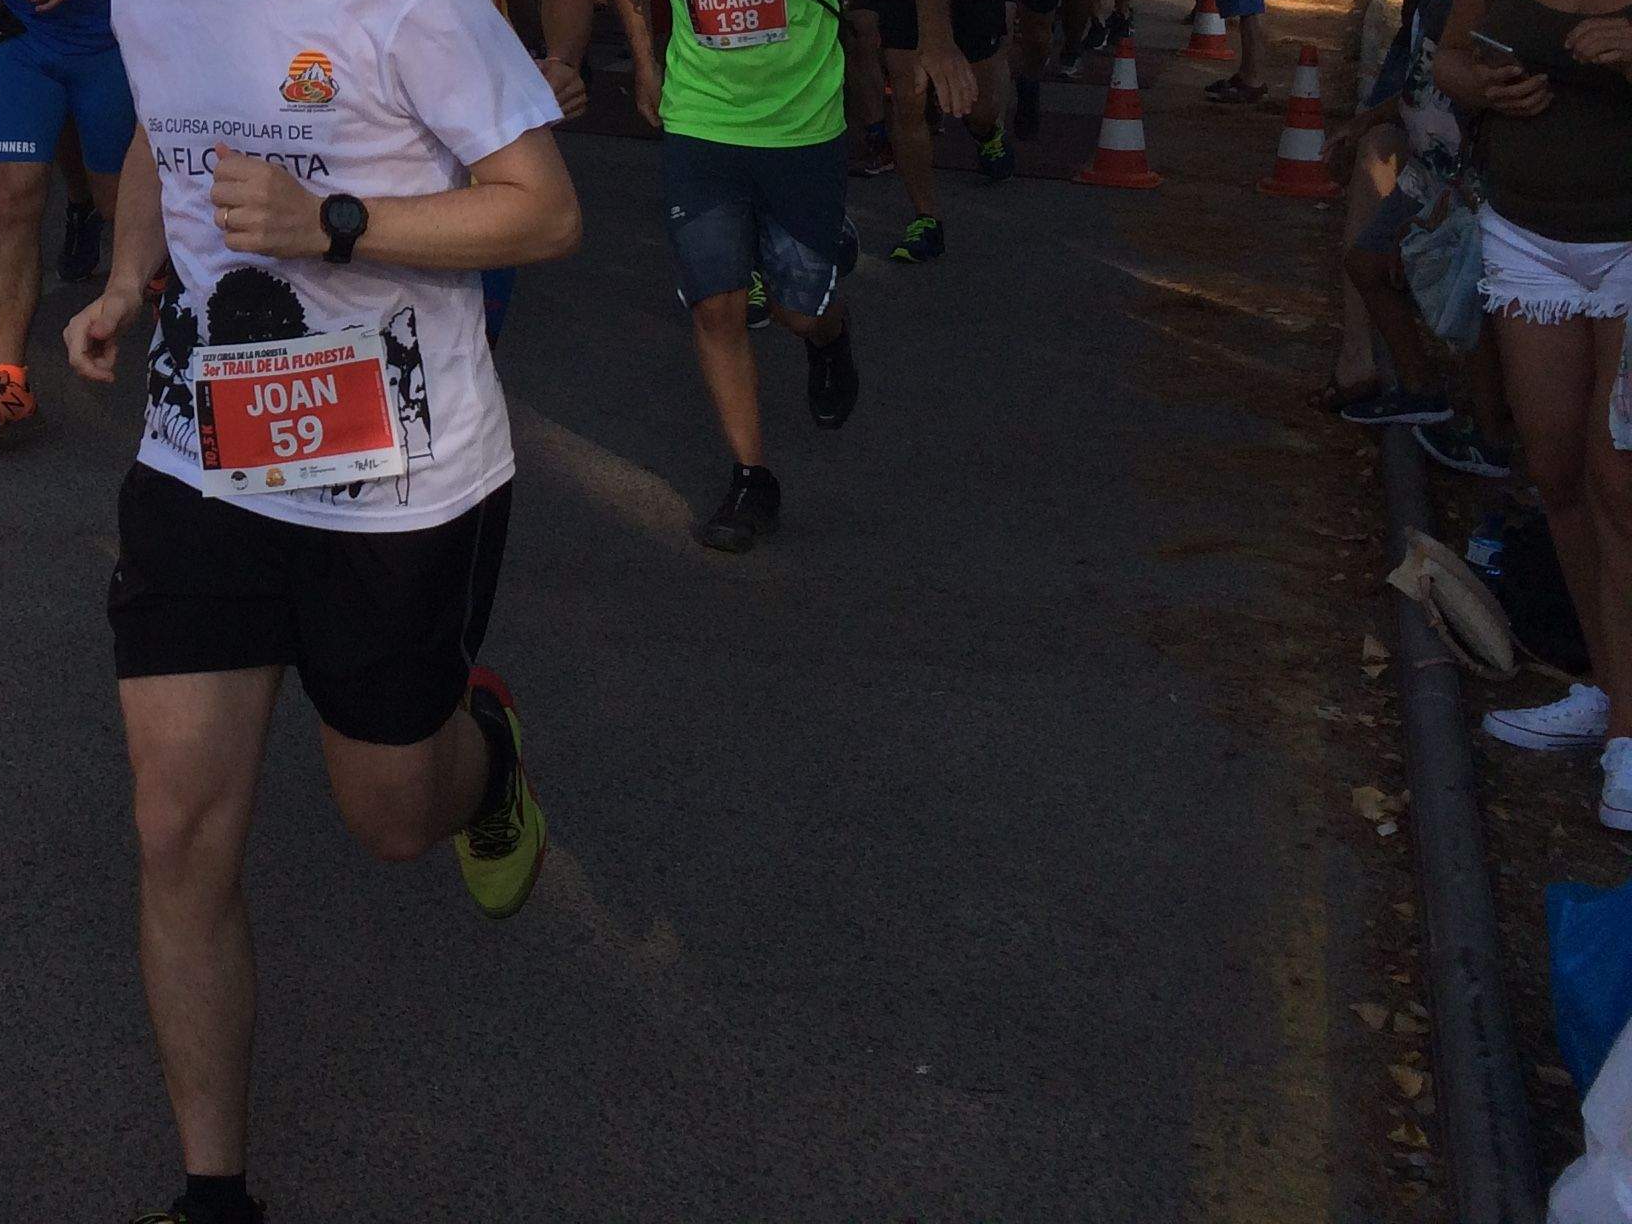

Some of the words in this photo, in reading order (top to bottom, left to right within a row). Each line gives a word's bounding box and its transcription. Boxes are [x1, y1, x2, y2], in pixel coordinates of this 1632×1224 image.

[717, 9, 759, 33] 138
[165, 118, 209, 135] CURSA
[213, 119, 283, 140] POPULAR
[288, 124, 314, 140] DE
[202, 362, 221, 377] 3er
[223, 360, 255, 376] TRAIL
[256, 359, 272, 373] DE
[274, 356, 290, 371] LA
[291, 345, 355, 370] FLORESTA
[246, 374, 339, 417] JOAN
[269, 414, 324, 458] 59
